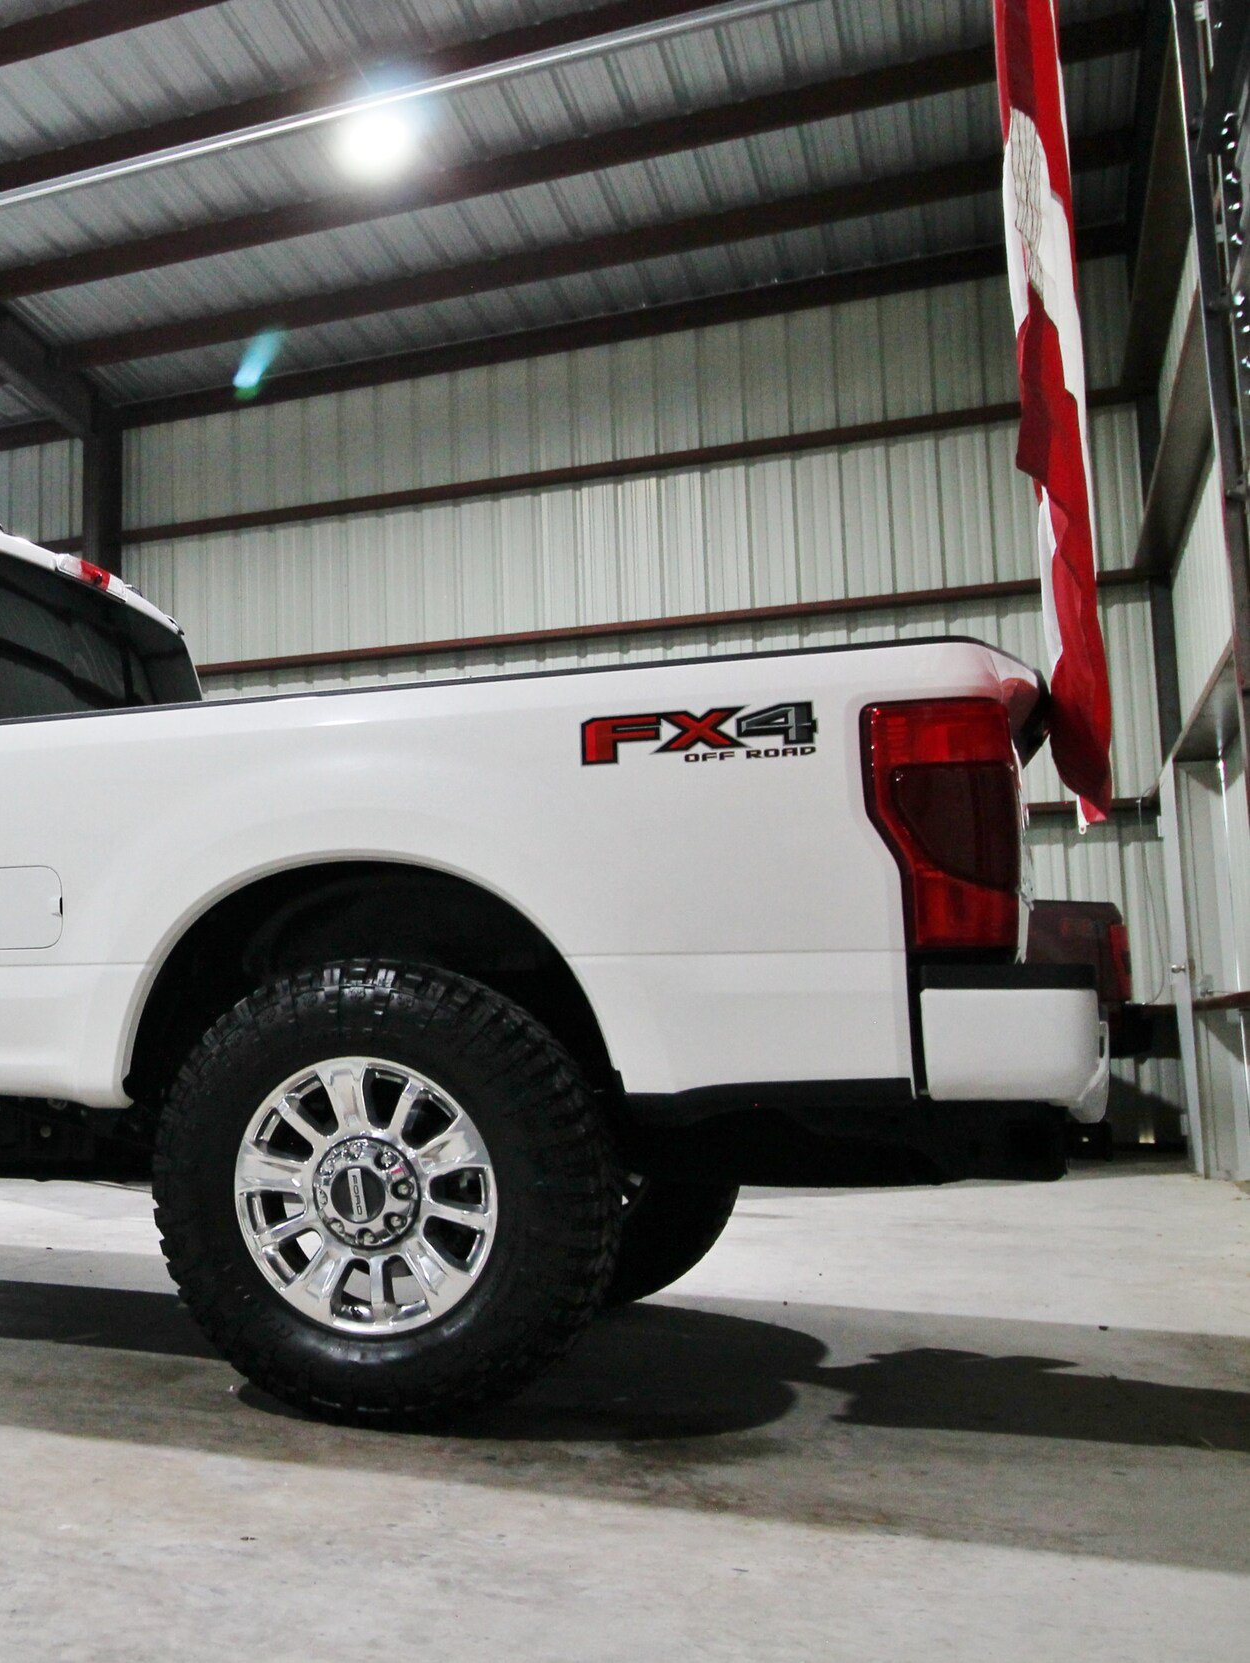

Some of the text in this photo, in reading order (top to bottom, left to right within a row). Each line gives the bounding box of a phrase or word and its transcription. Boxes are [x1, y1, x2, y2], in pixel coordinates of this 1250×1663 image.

[580, 700, 818, 766] FX4
[684, 745, 817, 763] OFF ROAD
[352, 1175, 362, 1215] FORD
